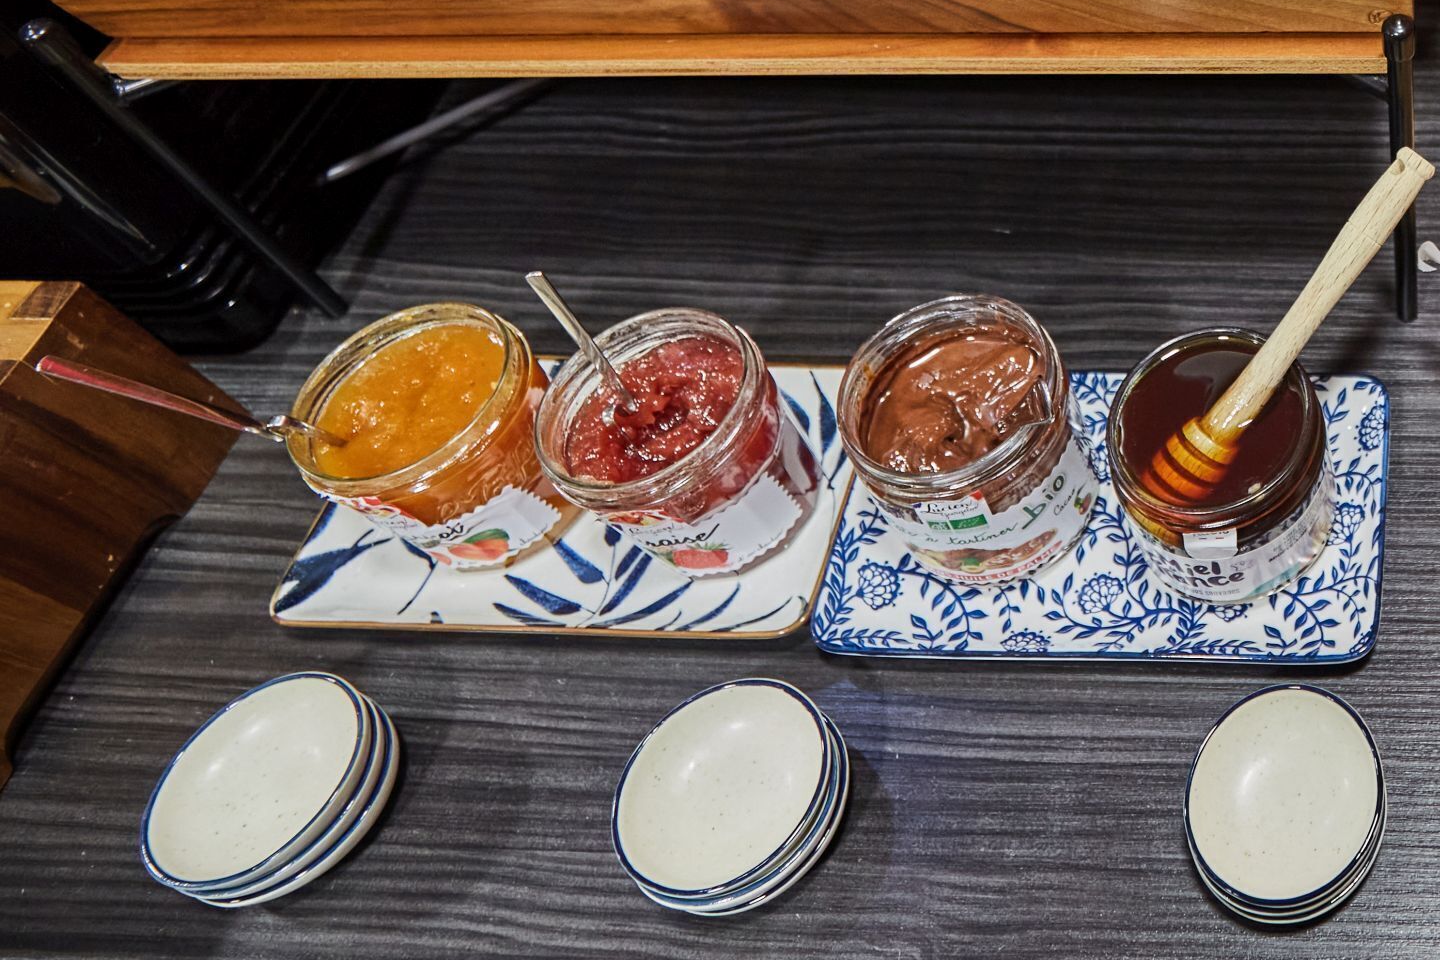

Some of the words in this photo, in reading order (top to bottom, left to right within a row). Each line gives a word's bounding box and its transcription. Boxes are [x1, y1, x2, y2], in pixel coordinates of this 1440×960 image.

[1021, 474, 1066, 530] bio
[637, 523, 720, 548] raise
[947, 522, 1019, 545] tartiner
